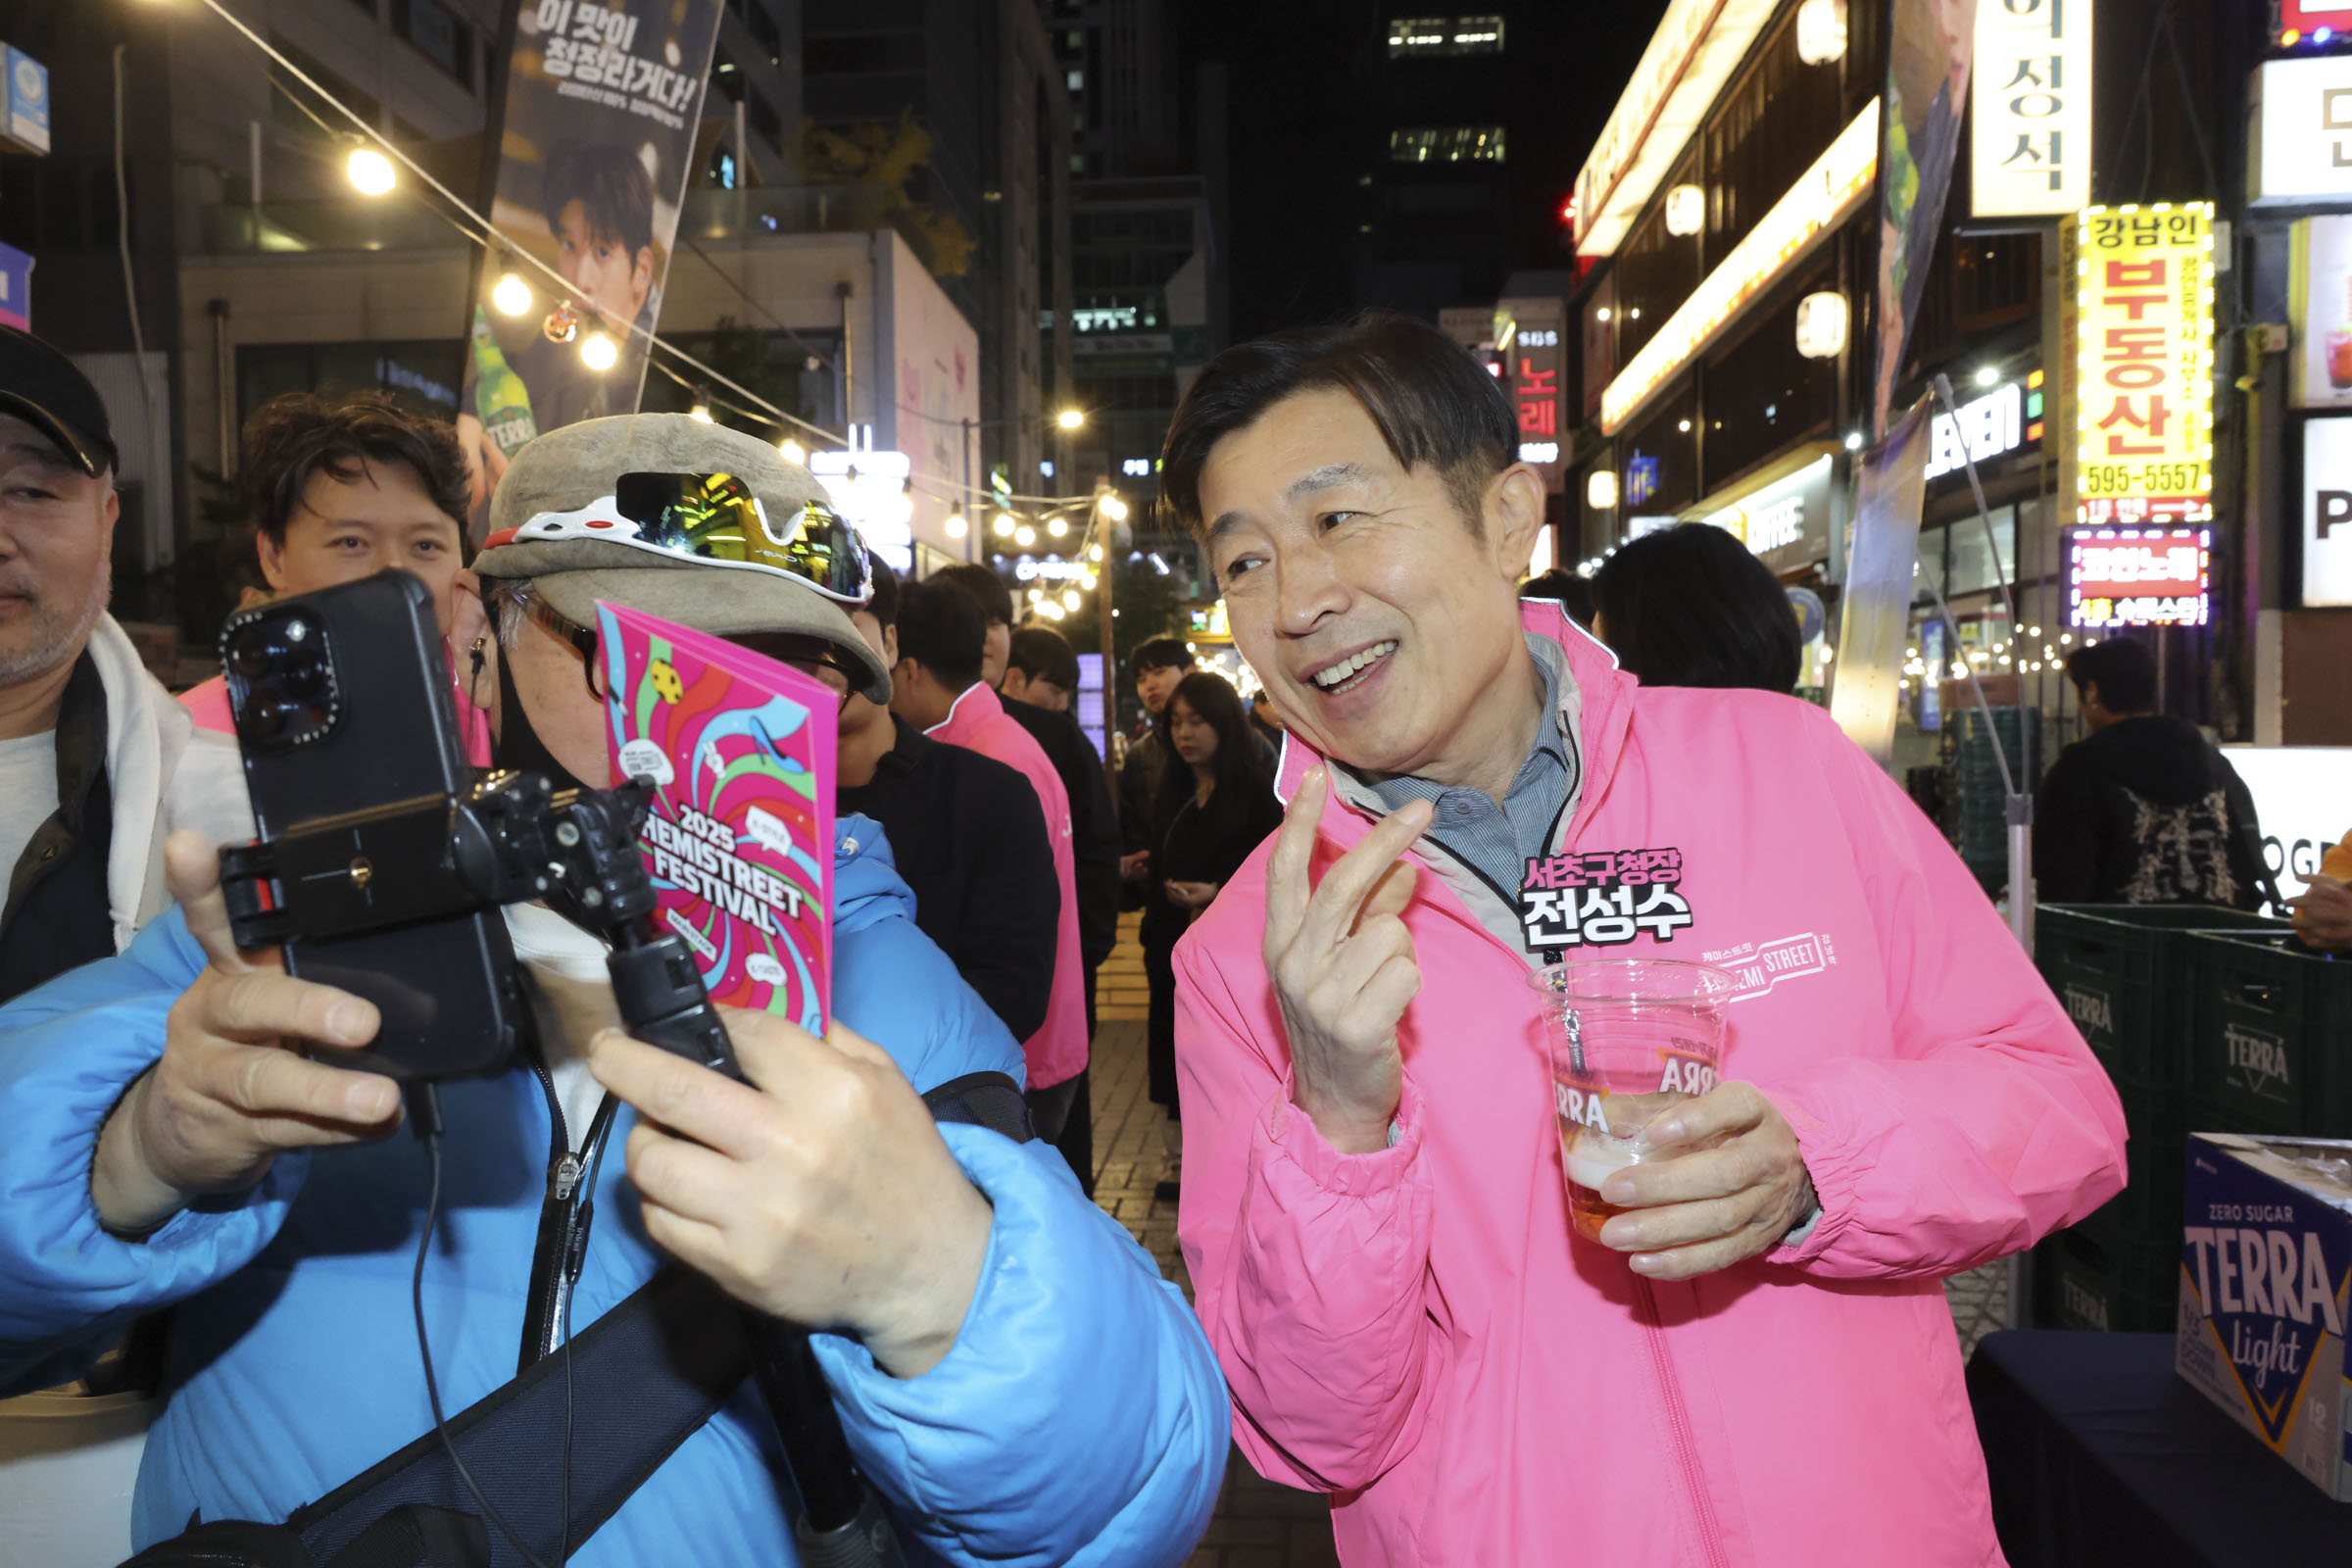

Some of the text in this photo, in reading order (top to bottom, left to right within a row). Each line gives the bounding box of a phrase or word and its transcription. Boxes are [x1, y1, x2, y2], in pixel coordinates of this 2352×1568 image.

[537, 0, 639, 52] 이 맛이
[2094, 214, 2197, 248] 강남인
[2097, 259, 2173, 456] 부동산
[2088, 464, 2201, 492] 595-5557
[679, 804, 736, 853] 2025
[641, 812, 804, 919] HEMISTREET
[1524, 850, 1682, 889] 서초구청장
[2262, 834, 2337, 881] OG
[653, 846, 778, 937] FESTIVAL
[1524, 885, 1692, 947] 전성수
[1701, 942, 1754, 962] 케미스트릿
[1763, 943, 1815, 973] STREET
[2064, 988, 2113, 1034] TERRA
[2225, 1029, 2289, 1084] TERRA
[2209, 1204, 2295, 1224] ZERO SUGAR
[572, 1227, 584, 1251] Inkel
[2183, 1226, 2345, 1337] TERRA
[2232, 1319, 2302, 1391] Light
